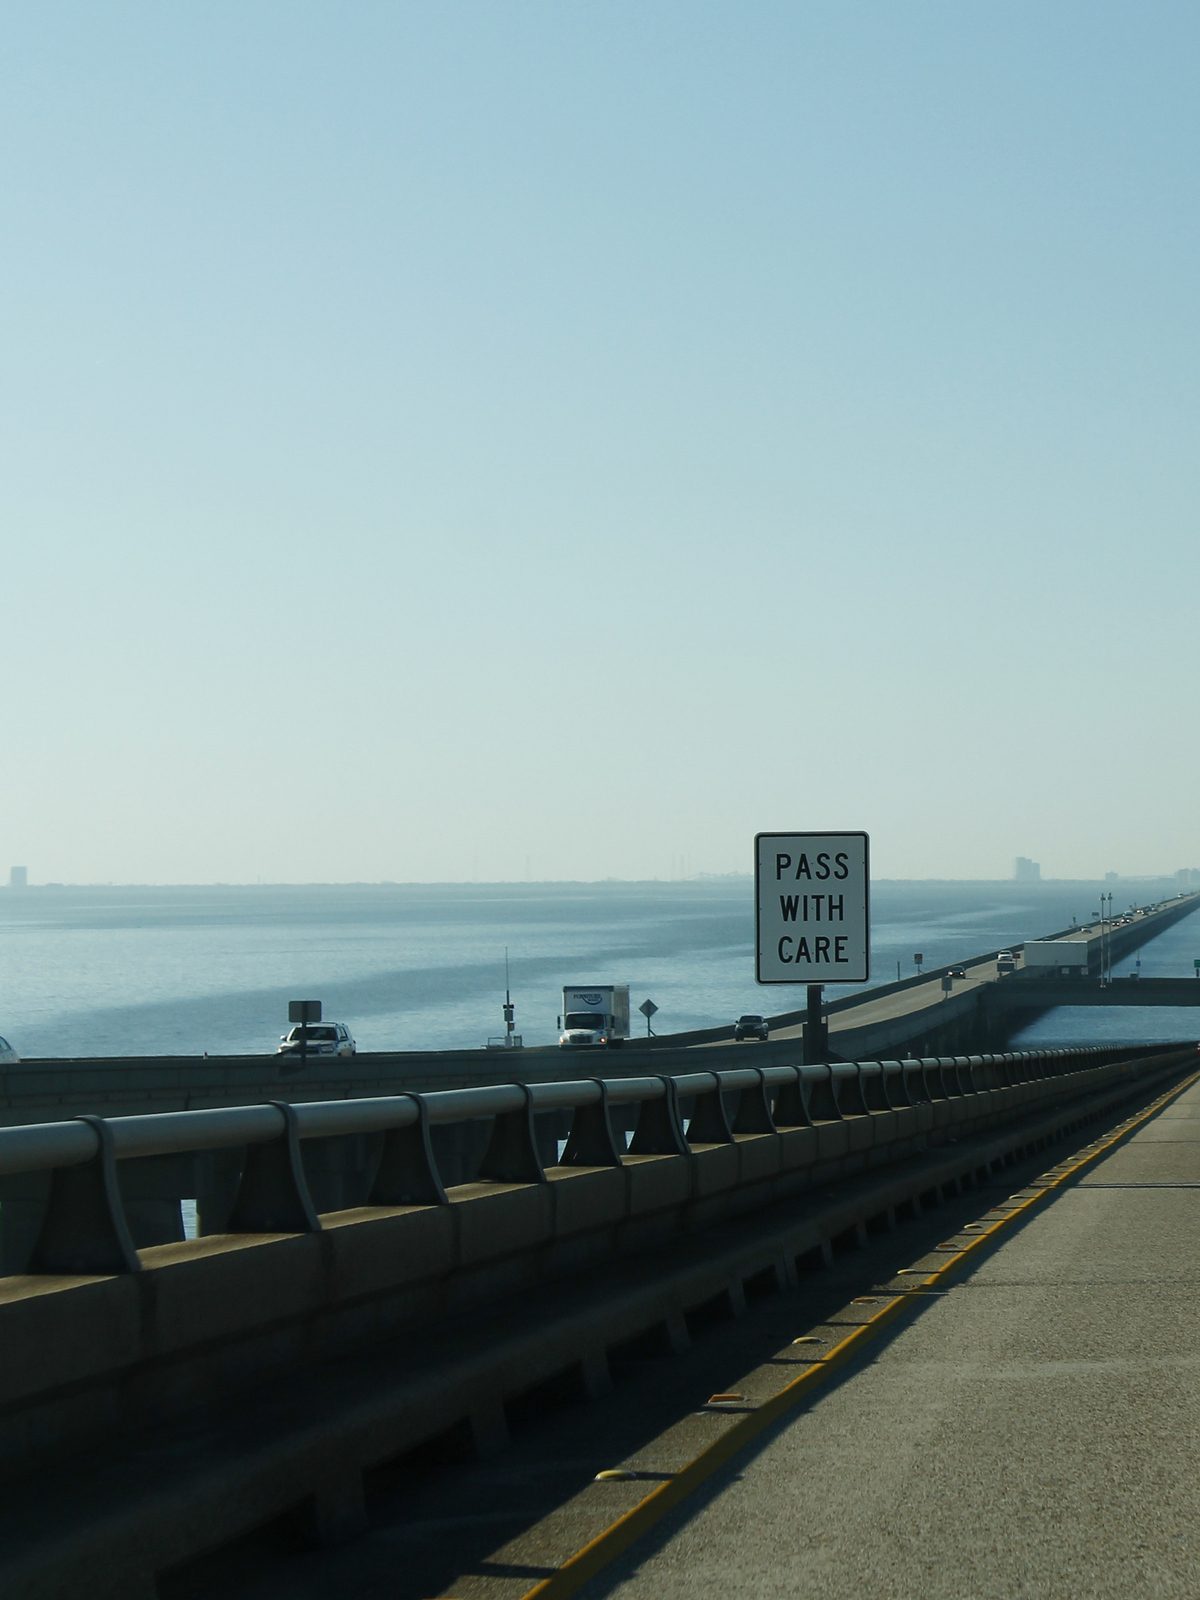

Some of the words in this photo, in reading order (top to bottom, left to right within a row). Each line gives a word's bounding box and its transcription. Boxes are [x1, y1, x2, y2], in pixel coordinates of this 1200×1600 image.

[776, 853, 849, 880] PASS
[780, 895, 844, 921] WITH
[778, 936, 849, 963] CARE
